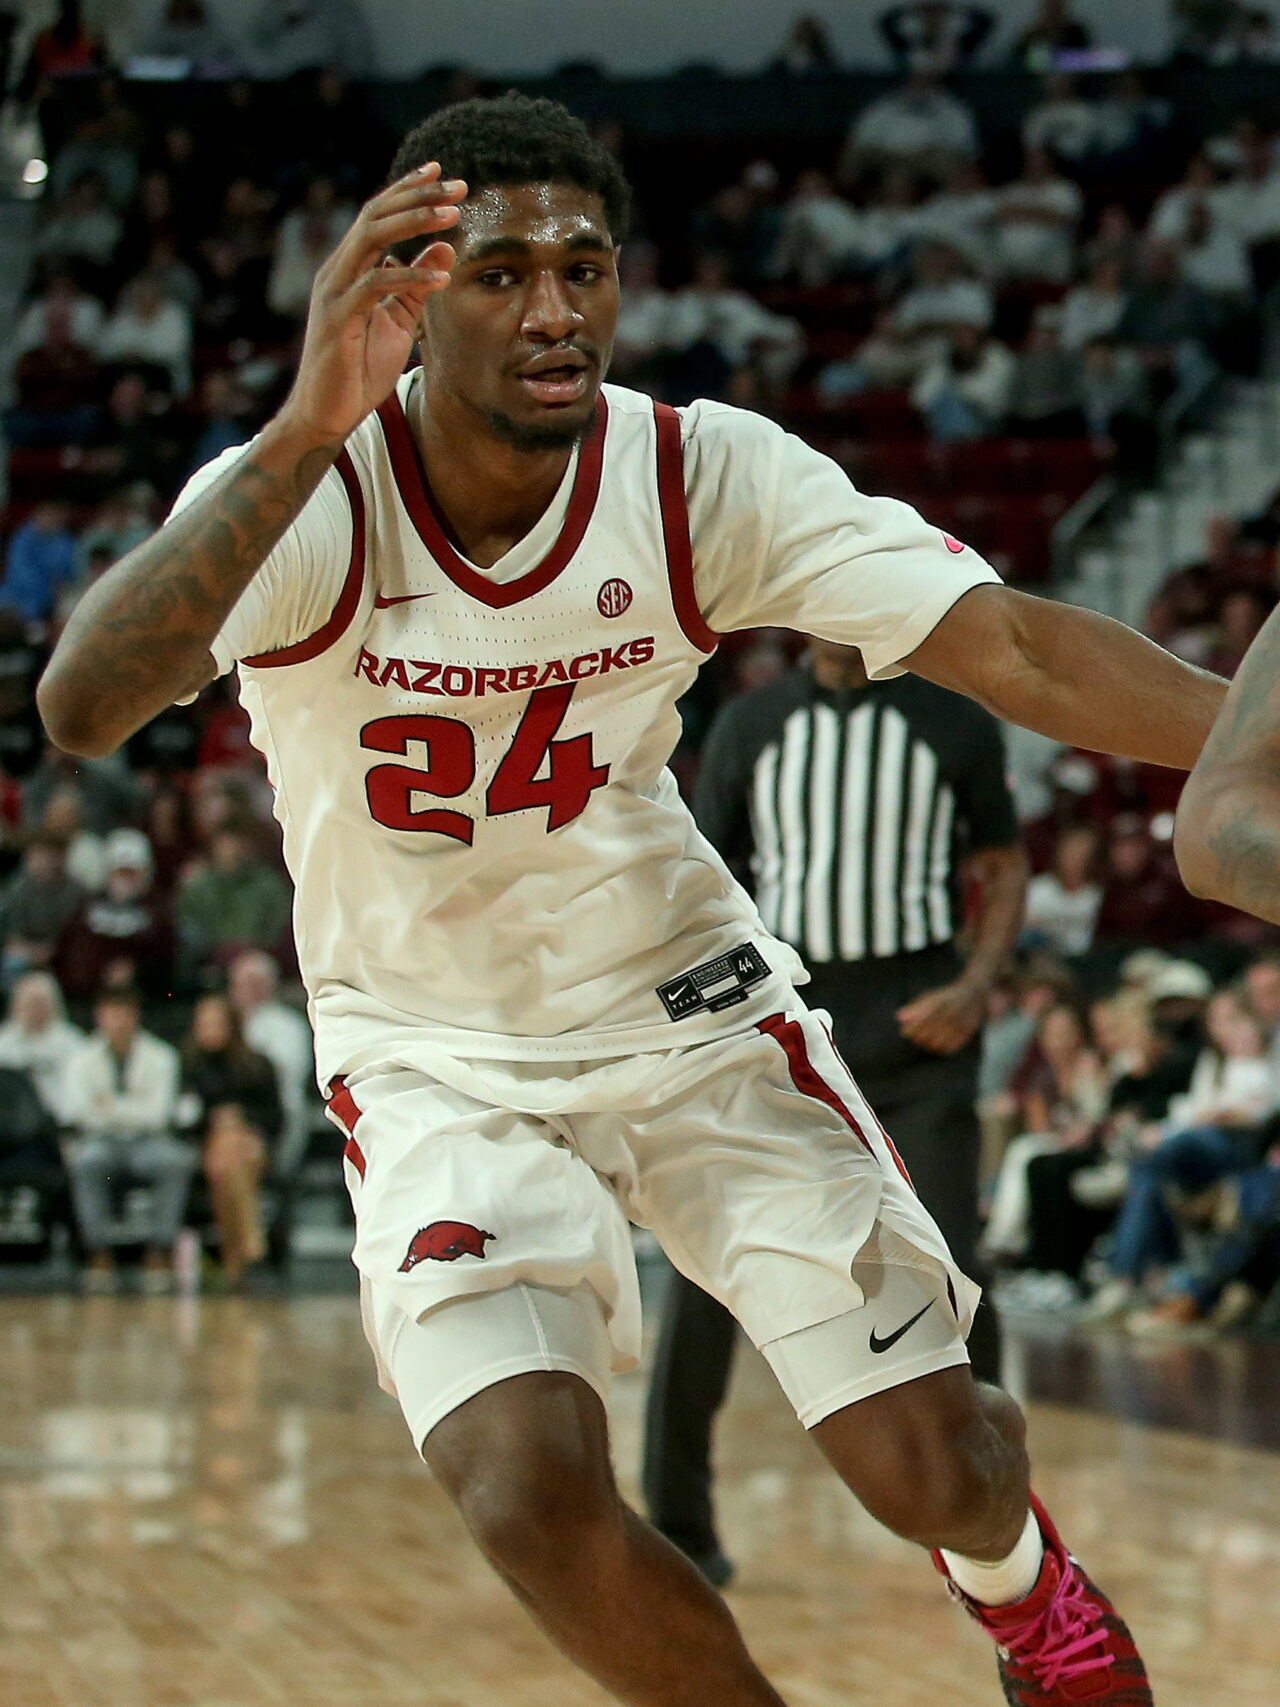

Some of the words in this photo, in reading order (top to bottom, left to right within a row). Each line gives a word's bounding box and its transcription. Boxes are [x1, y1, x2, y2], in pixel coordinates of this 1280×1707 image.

[599, 581, 631, 616] SEC
[354, 636, 655, 697] RAZORBACKS
[360, 681, 612, 847] 24
[738, 956, 754, 974] 44
[673, 994, 699, 1009] TEAM
